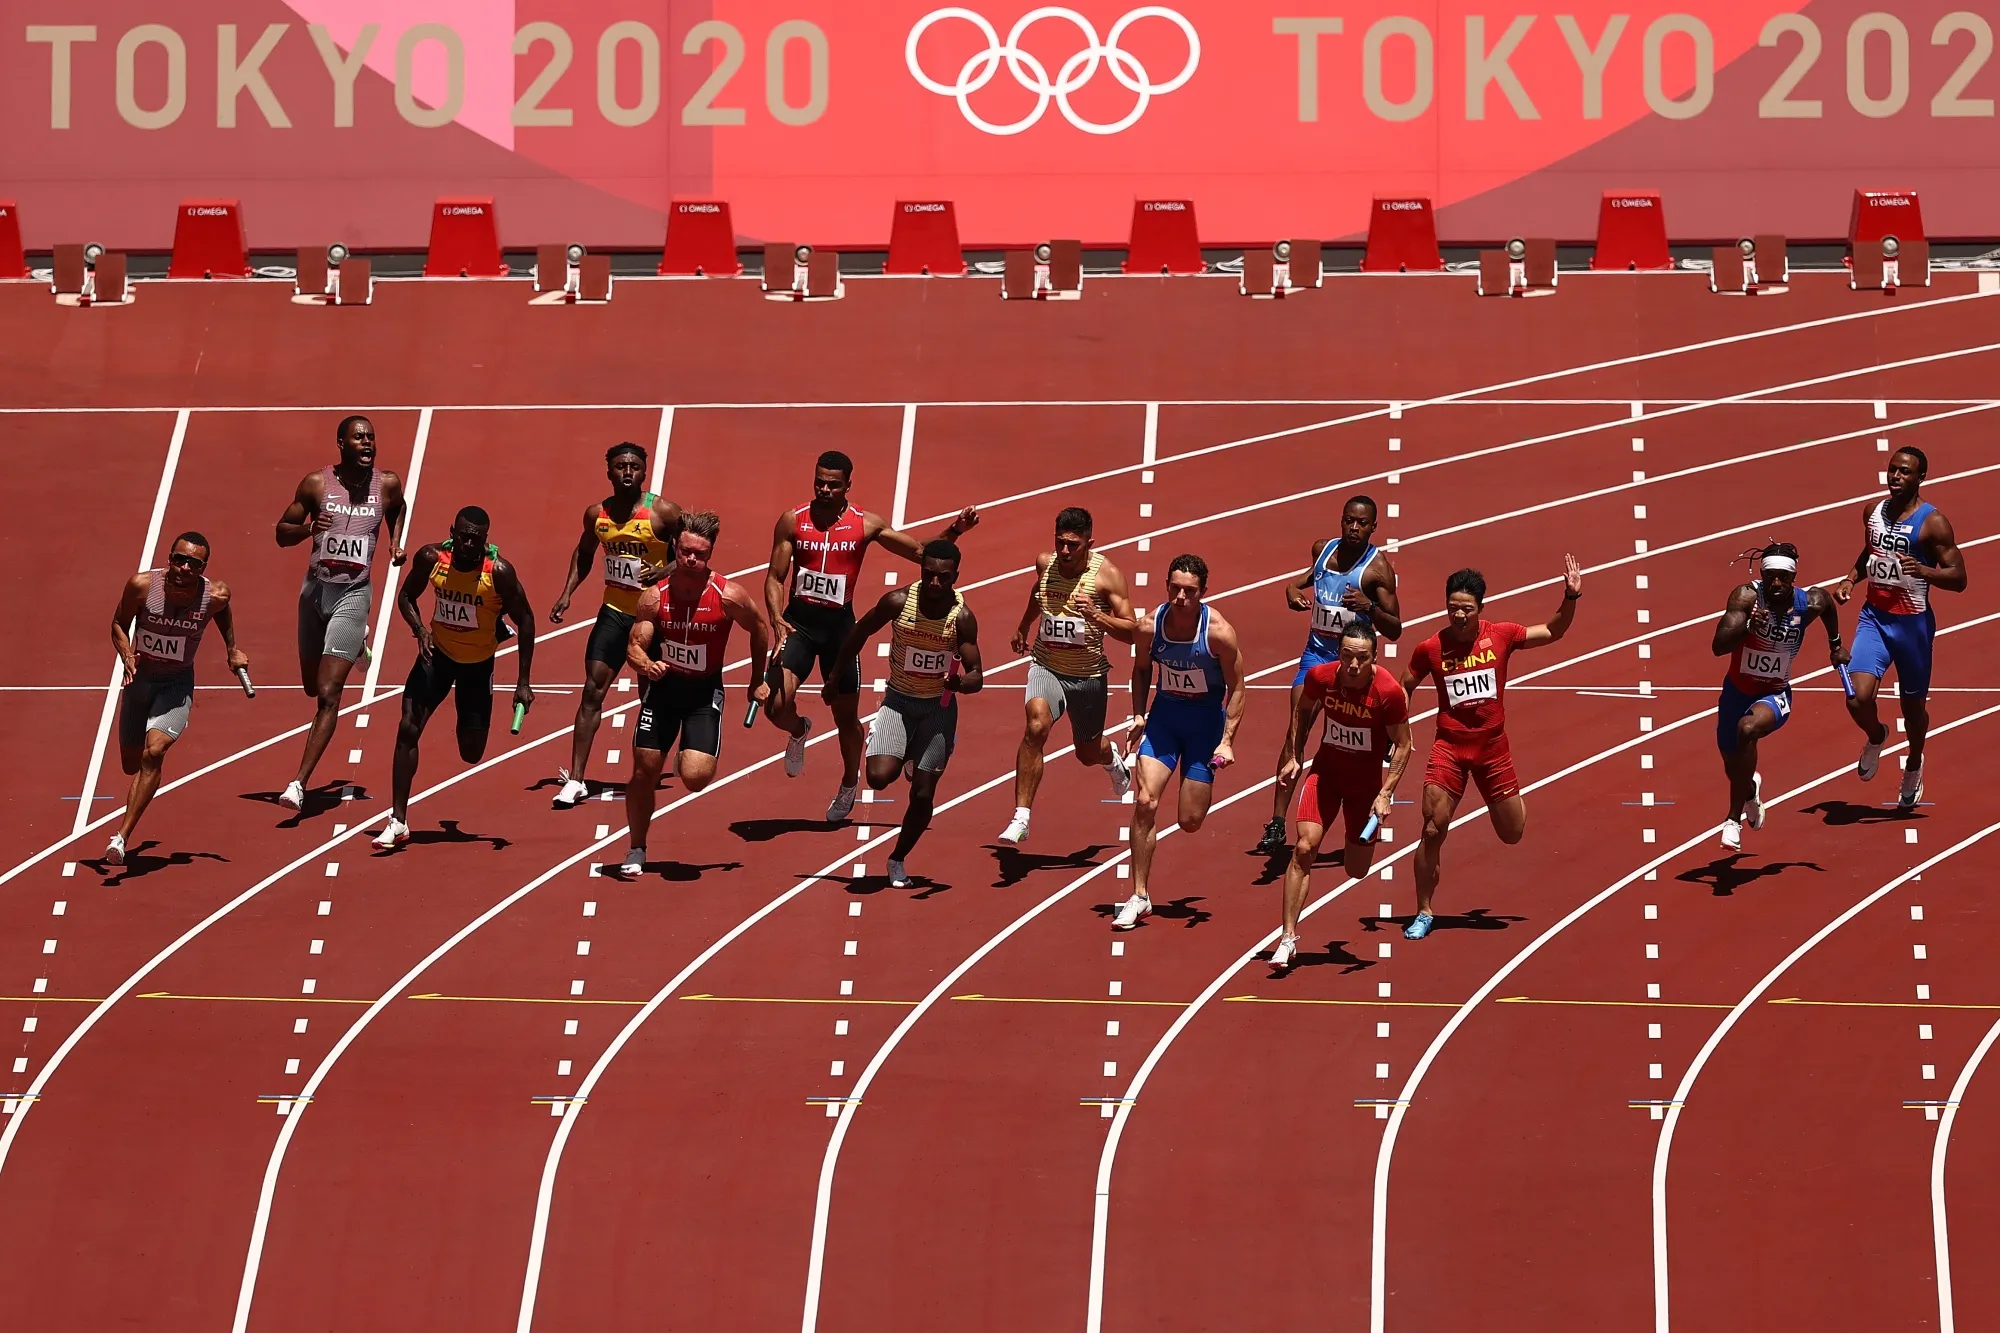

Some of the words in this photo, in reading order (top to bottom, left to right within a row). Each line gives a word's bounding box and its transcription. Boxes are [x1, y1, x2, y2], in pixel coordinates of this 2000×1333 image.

[26, 23, 465, 129] TOKYO
[510, 20, 829, 127] 2020
[1273, 14, 1715, 122] TOKYO
[1758, 11, 1995, 118] 202
[197, 207, 228, 216] OMEGA
[452, 206, 484, 216] OMEGA
[688, 204, 721, 214] OMEGA
[914, 203, 946, 213] OMEGA
[1154, 202, 1185, 212] OMEGA
[1390, 201, 1421, 211] OMEGA
[1621, 199, 1653, 208] OMEGA
[1879, 198, 1911, 207] OMEGA
[325, 502, 376, 517] CANADA
[326, 537, 363, 558] CAN
[796, 540, 857, 552] DENMARK
[1870, 528, 1909, 554] USA
[605, 558, 634, 581] GHA
[1870, 558, 1900, 581] USA
[803, 573, 839, 596] DEN
[438, 600, 469, 622] GHA
[1315, 606, 1343, 628] ITA
[147, 614, 196, 630] CANADA
[660, 620, 717, 632] DENMARK
[1043, 618, 1076, 638] GER
[1756, 622, 1799, 645] USA
[142, 634, 178, 655] CAN
[667, 644, 699, 665] DEN
[912, 651, 945, 670] GER
[1441, 649, 1497, 671] CHINA
[1746, 652, 1781, 674] USA
[1166, 670, 1196, 690] ITA
[1452, 673, 1490, 697] CHN
[1324, 695, 1373, 719] CHINA
[639, 707, 653, 732] DEN
[1330, 723, 1365, 746] CHN
